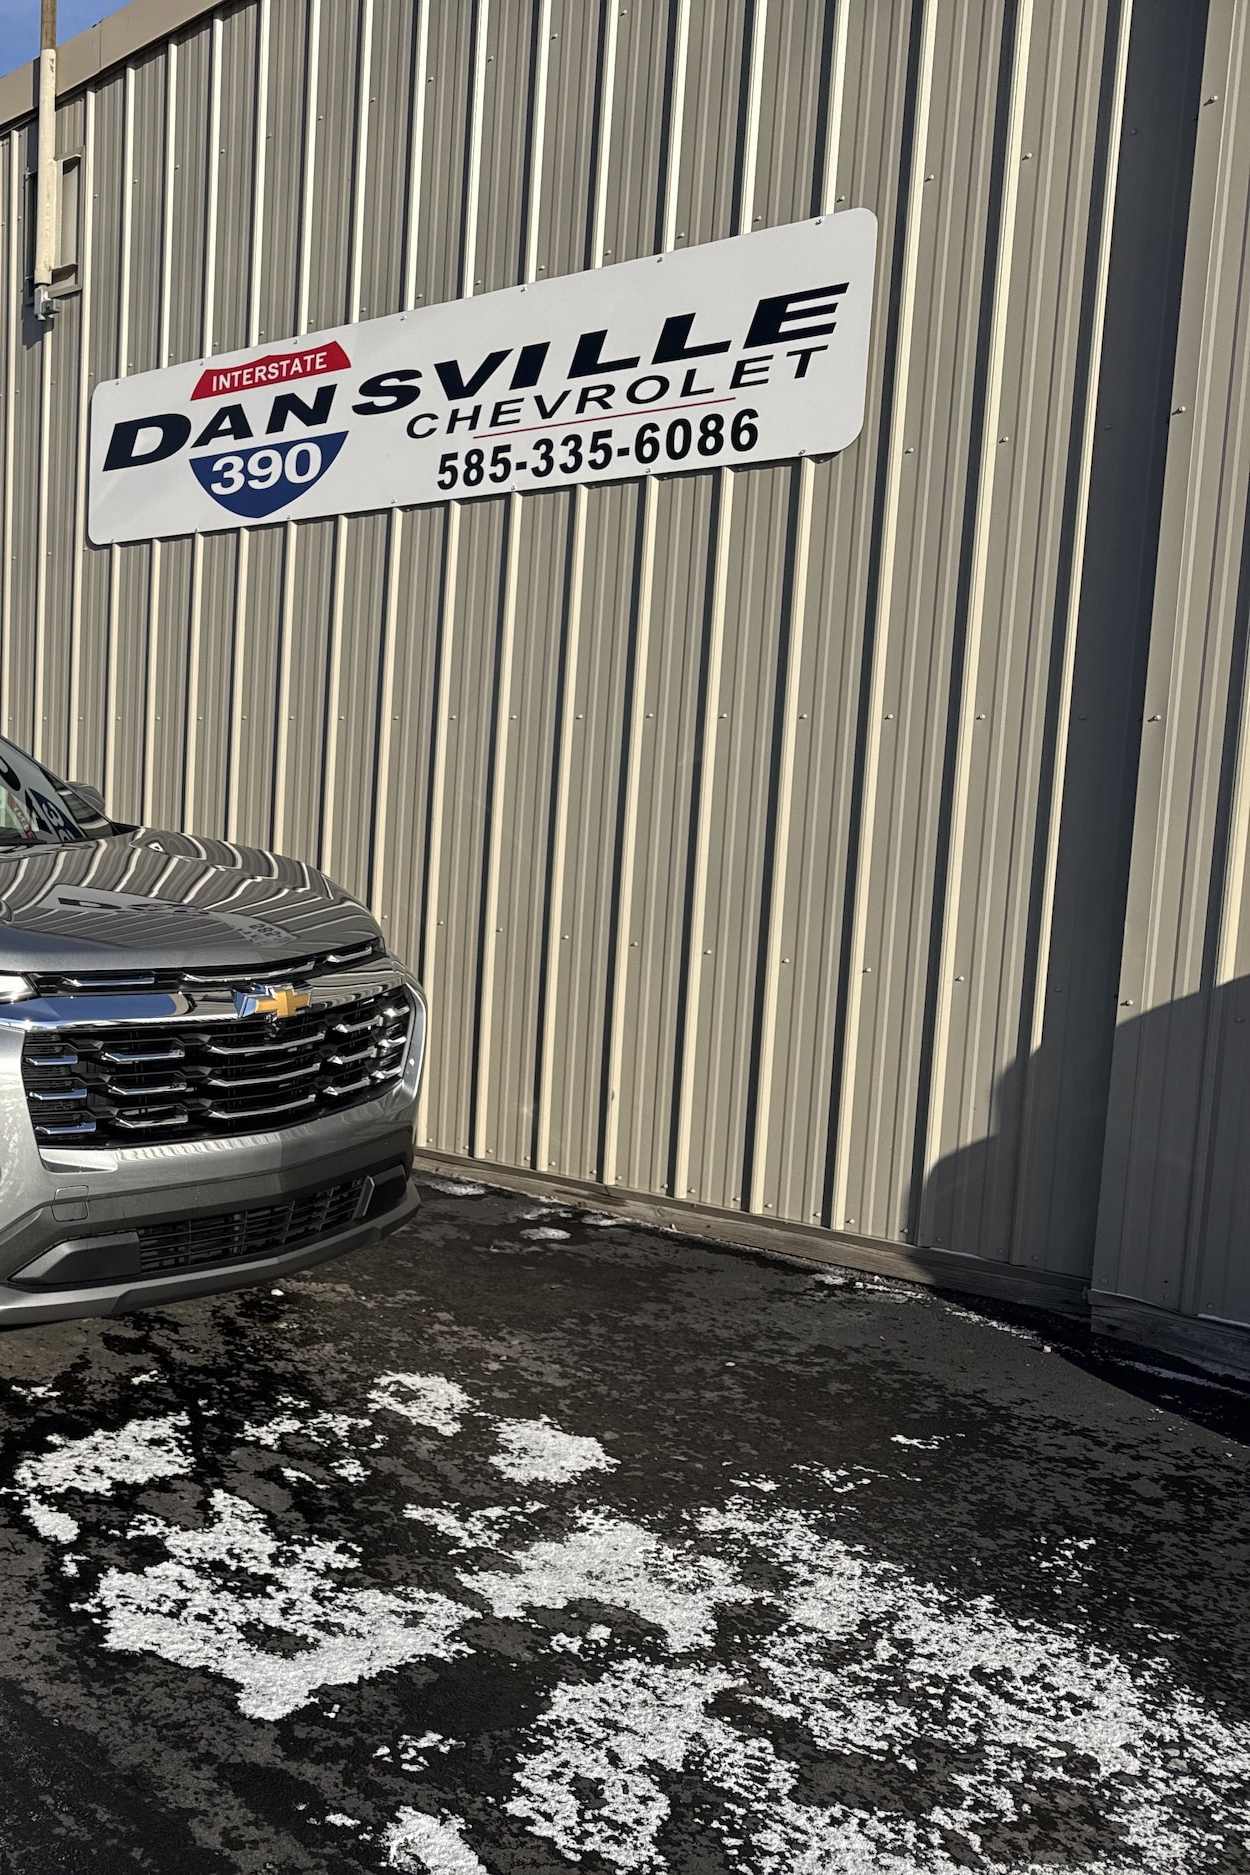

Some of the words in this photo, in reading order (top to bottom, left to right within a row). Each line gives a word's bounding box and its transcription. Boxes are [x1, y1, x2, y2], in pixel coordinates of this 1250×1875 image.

[102, 282, 850, 471] DANSVILLE
[210, 350, 328, 392] INTERSTATE
[406, 345, 829, 440] CHEVROLET
[210, 441, 323, 495] 390
[437, 408, 760, 490] 585-335-6086
